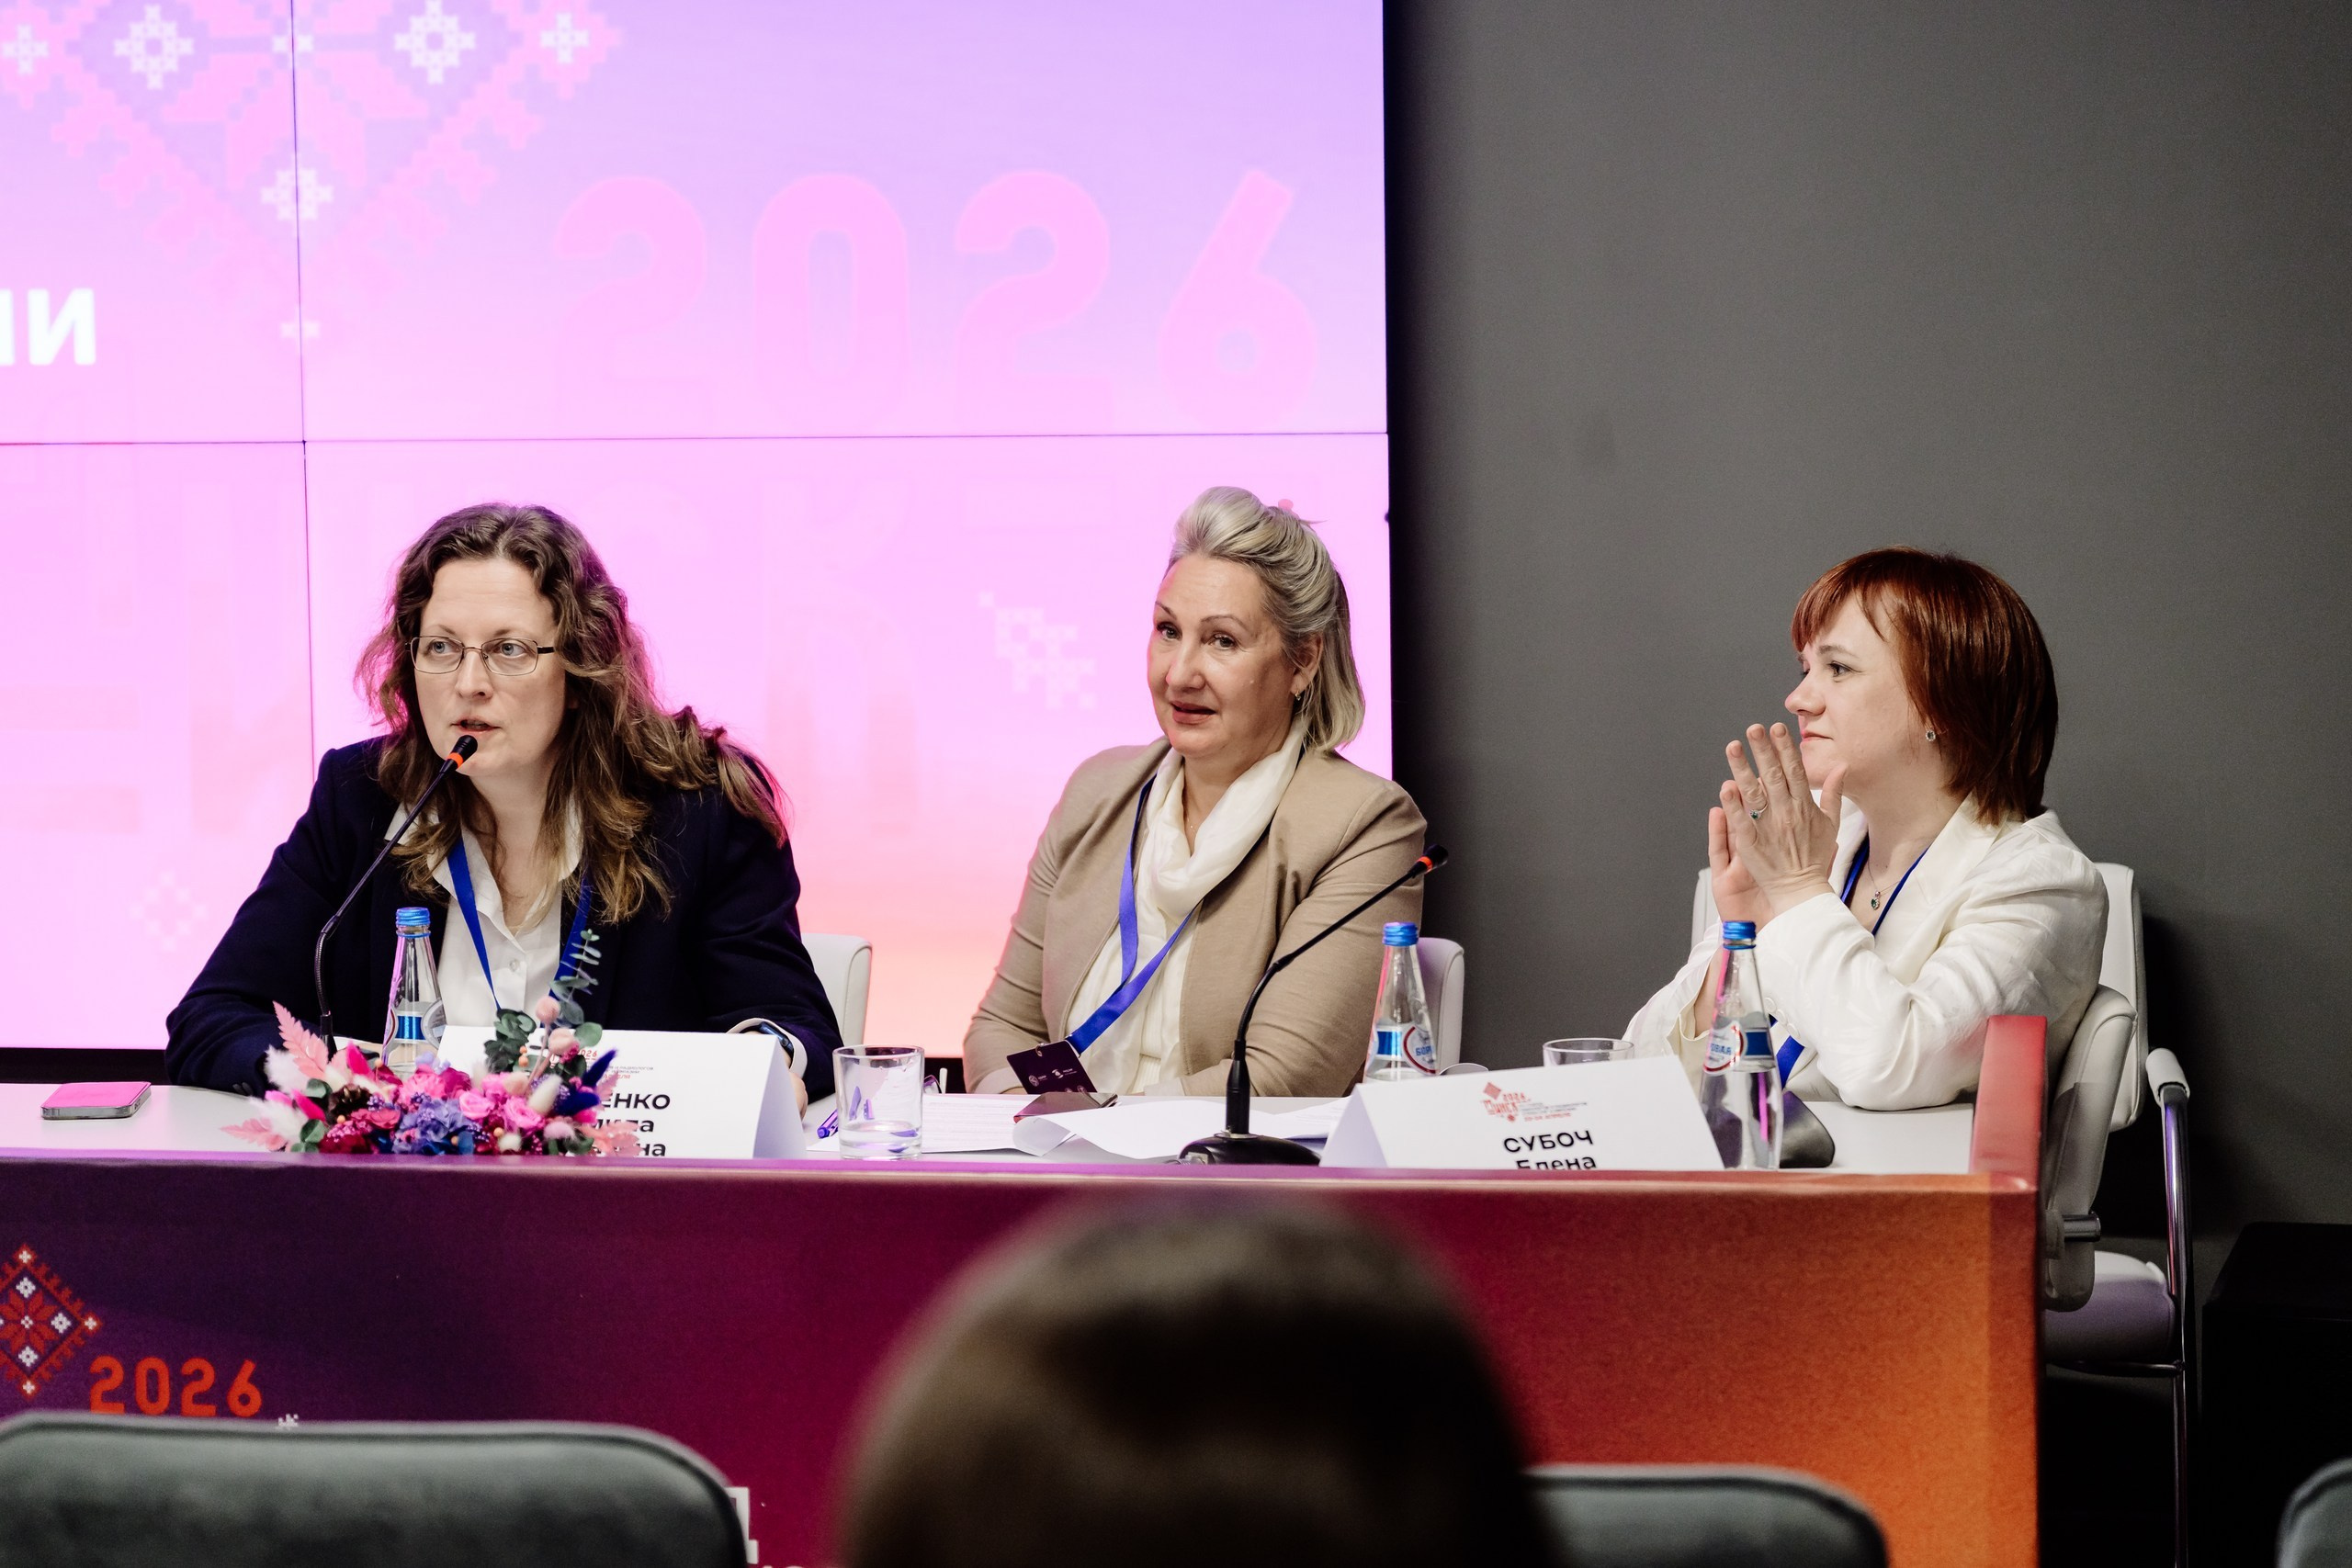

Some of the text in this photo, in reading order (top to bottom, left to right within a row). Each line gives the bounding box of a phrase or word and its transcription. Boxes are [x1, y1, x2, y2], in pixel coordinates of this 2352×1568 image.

[556, 168, 1317, 428] 2026
[1503, 1130, 1593, 1153] СУБОЧ
[89, 1355, 263, 1417] 2026
